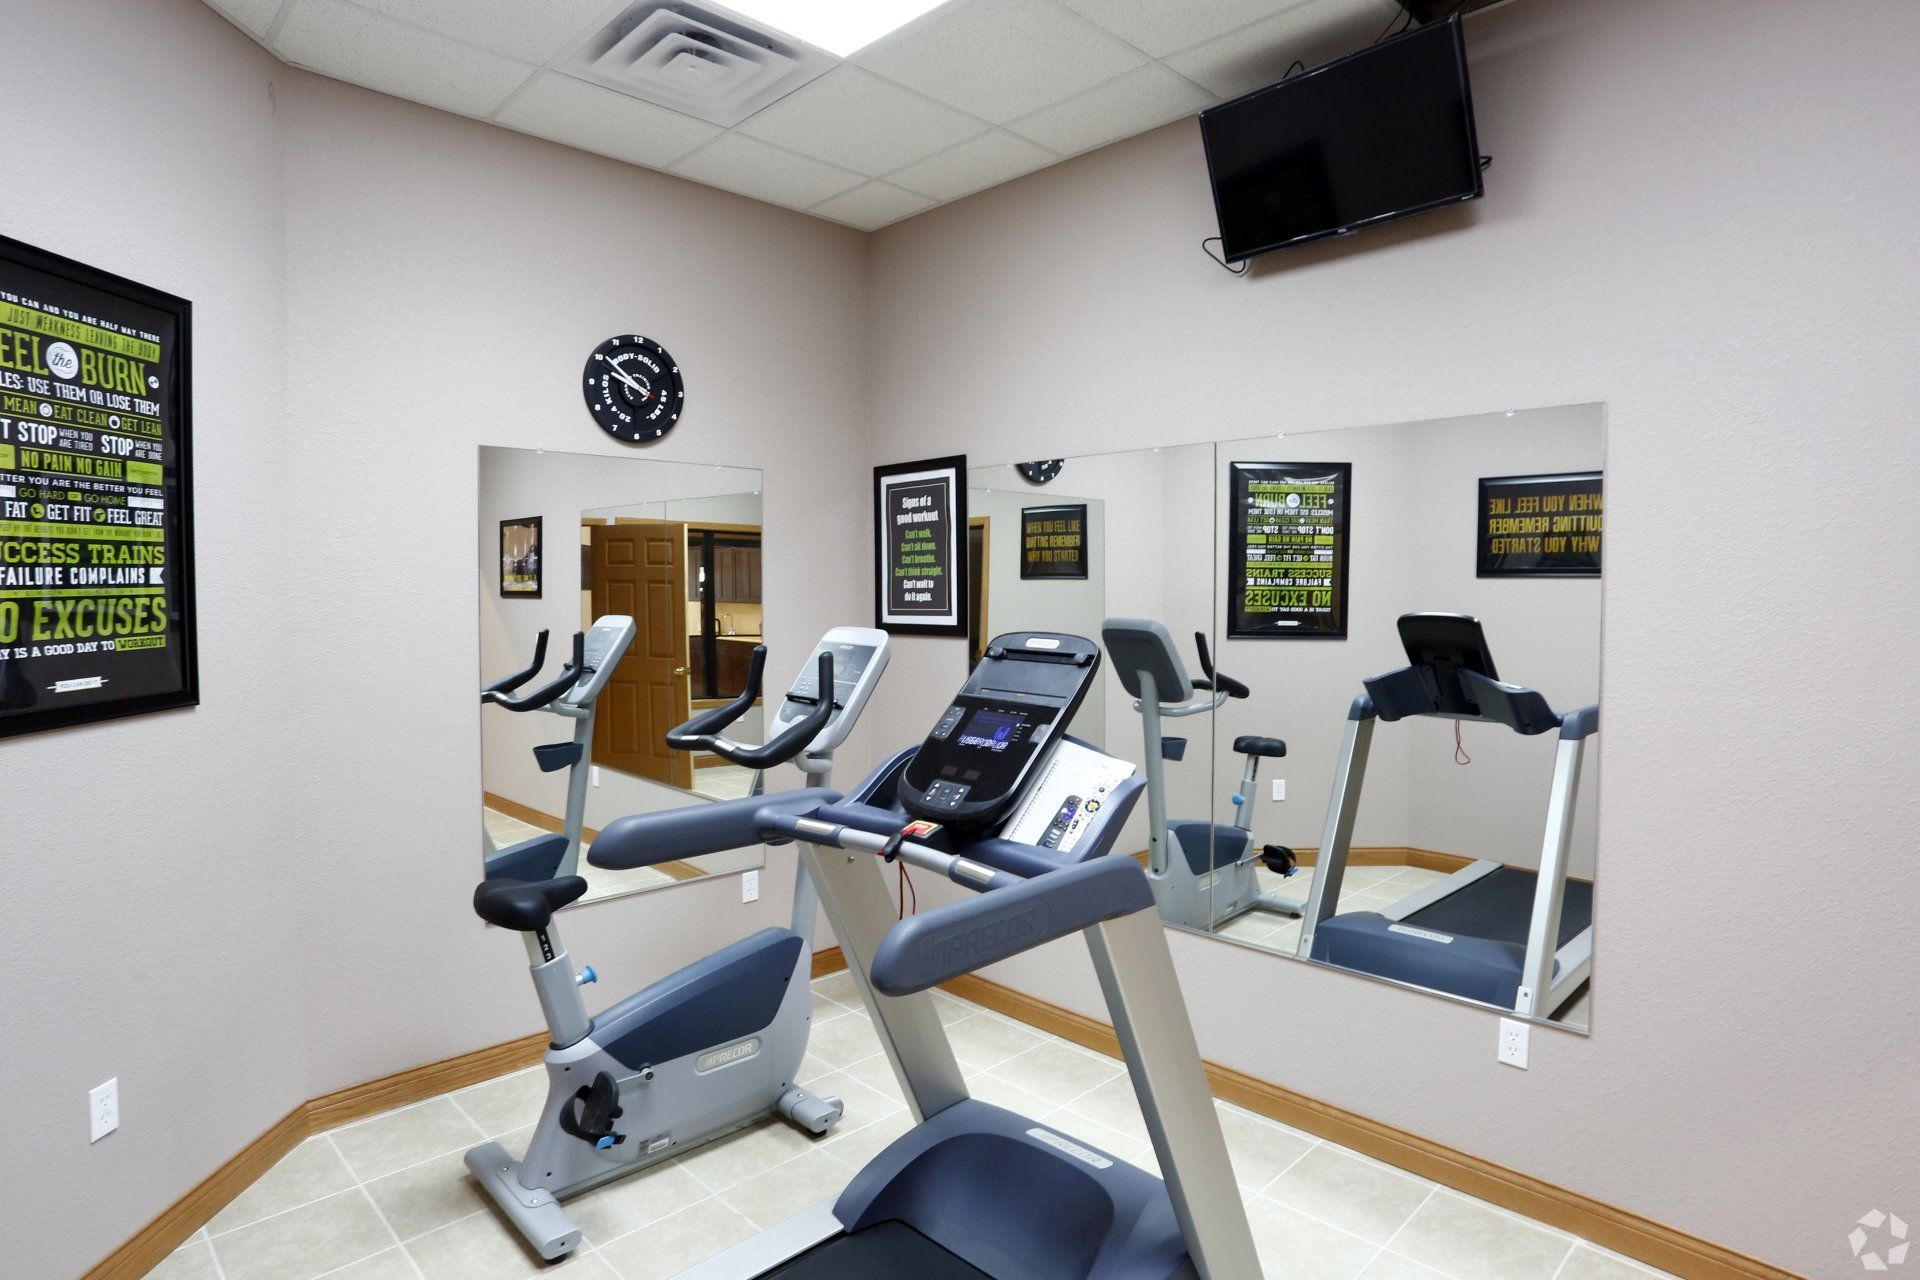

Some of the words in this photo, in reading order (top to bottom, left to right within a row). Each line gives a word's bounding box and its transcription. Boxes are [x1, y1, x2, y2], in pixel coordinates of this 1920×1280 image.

[0, 291, 18, 302] YOU
[21, 298, 39, 309] CAN
[43, 304, 59, 314] AND
[63, 310, 79, 320] YOU
[82, 315, 97, 325] ARE
[100, 320, 118, 330] HALF
[121, 326, 136, 335] WAY
[140, 331, 160, 342] THERE
[8, 308, 29, 326] JUST
[37, 315, 80, 339] WEAKNESS
[86, 329, 116, 349] LEAVING
[0, 328, 49, 375] EEL
[53, 353, 72, 368] the
[81, 348, 147, 396] BURN
[612, 353, 660, 373] BODY-SOLID
[0, 371, 23, 389] LES:
[27, 377, 50, 395] USE
[53, 382, 87, 402] THEM
[89, 390, 104, 405] OR
[106, 393, 131, 410] LOSE
[134, 399, 160, 416] THEM
[602, 374, 612, 404] KILOS
[4, 396, 37, 414] MEAN
[54, 405, 72, 420] EAT
[77, 410, 107, 426] CLEAN
[122, 418, 138, 431] GET
[142, 421, 162, 435] LEAN
[0, 419, 11, 439] T
[18, 422, 57, 445] STOP
[59, 428, 78, 438] WHEN
[81, 432, 93, 441] YOU
[59, 439, 72, 448] ARE
[74, 441, 93, 451] TIRED
[101, 435, 134, 456] STOP
[135, 440, 151, 449] WHEN
[152, 443, 162, 451] YOU
[135, 450, 146, 458] ARE
[148, 451, 162, 460] DONE
[21, 450, 39, 468] NO
[43, 453, 72, 472] PAIN
[77, 457, 92, 474] NO
[96, 460, 121, 477] GAIN
[0, 474, 25, 483] TTER
[28, 477, 49, 485] YOU
[52, 479, 71, 487] ARE
[73, 481, 91, 490] THE
[93, 483, 125, 492] BETTER
[19, 488, 36, 498] GO
[39, 490, 65, 500] HARD
[84, 494, 99, 502] GO
[101, 495, 125, 505] HOME
[902, 497, 919, 509] Signs
[920, 495, 927, 506] of
[927, 496, 931, 506] a
[5, 501, 28, 518] FAT
[47, 504, 70, 520] GET
[73, 506, 92, 522] FIT
[107, 508, 132, 524] FEEL
[135, 511, 164, 526] GREAT
[897, 512, 912, 525] good
[912, 510, 939, 523] workout
[0, 542, 80, 563] CCESS
[88, 544, 164, 564] TRAINS
[70, 567, 145, 585] COMPLAINS
[32, 597, 166, 641] EXCUSES
[14, 648, 28, 658] IS
[31, 647, 41, 657] A
[44, 644, 74, 656] GOOD
[76, 642, 98, 653] DAY
[100, 641, 115, 650] TO
[118, 637, 163, 648] WORKOUT
